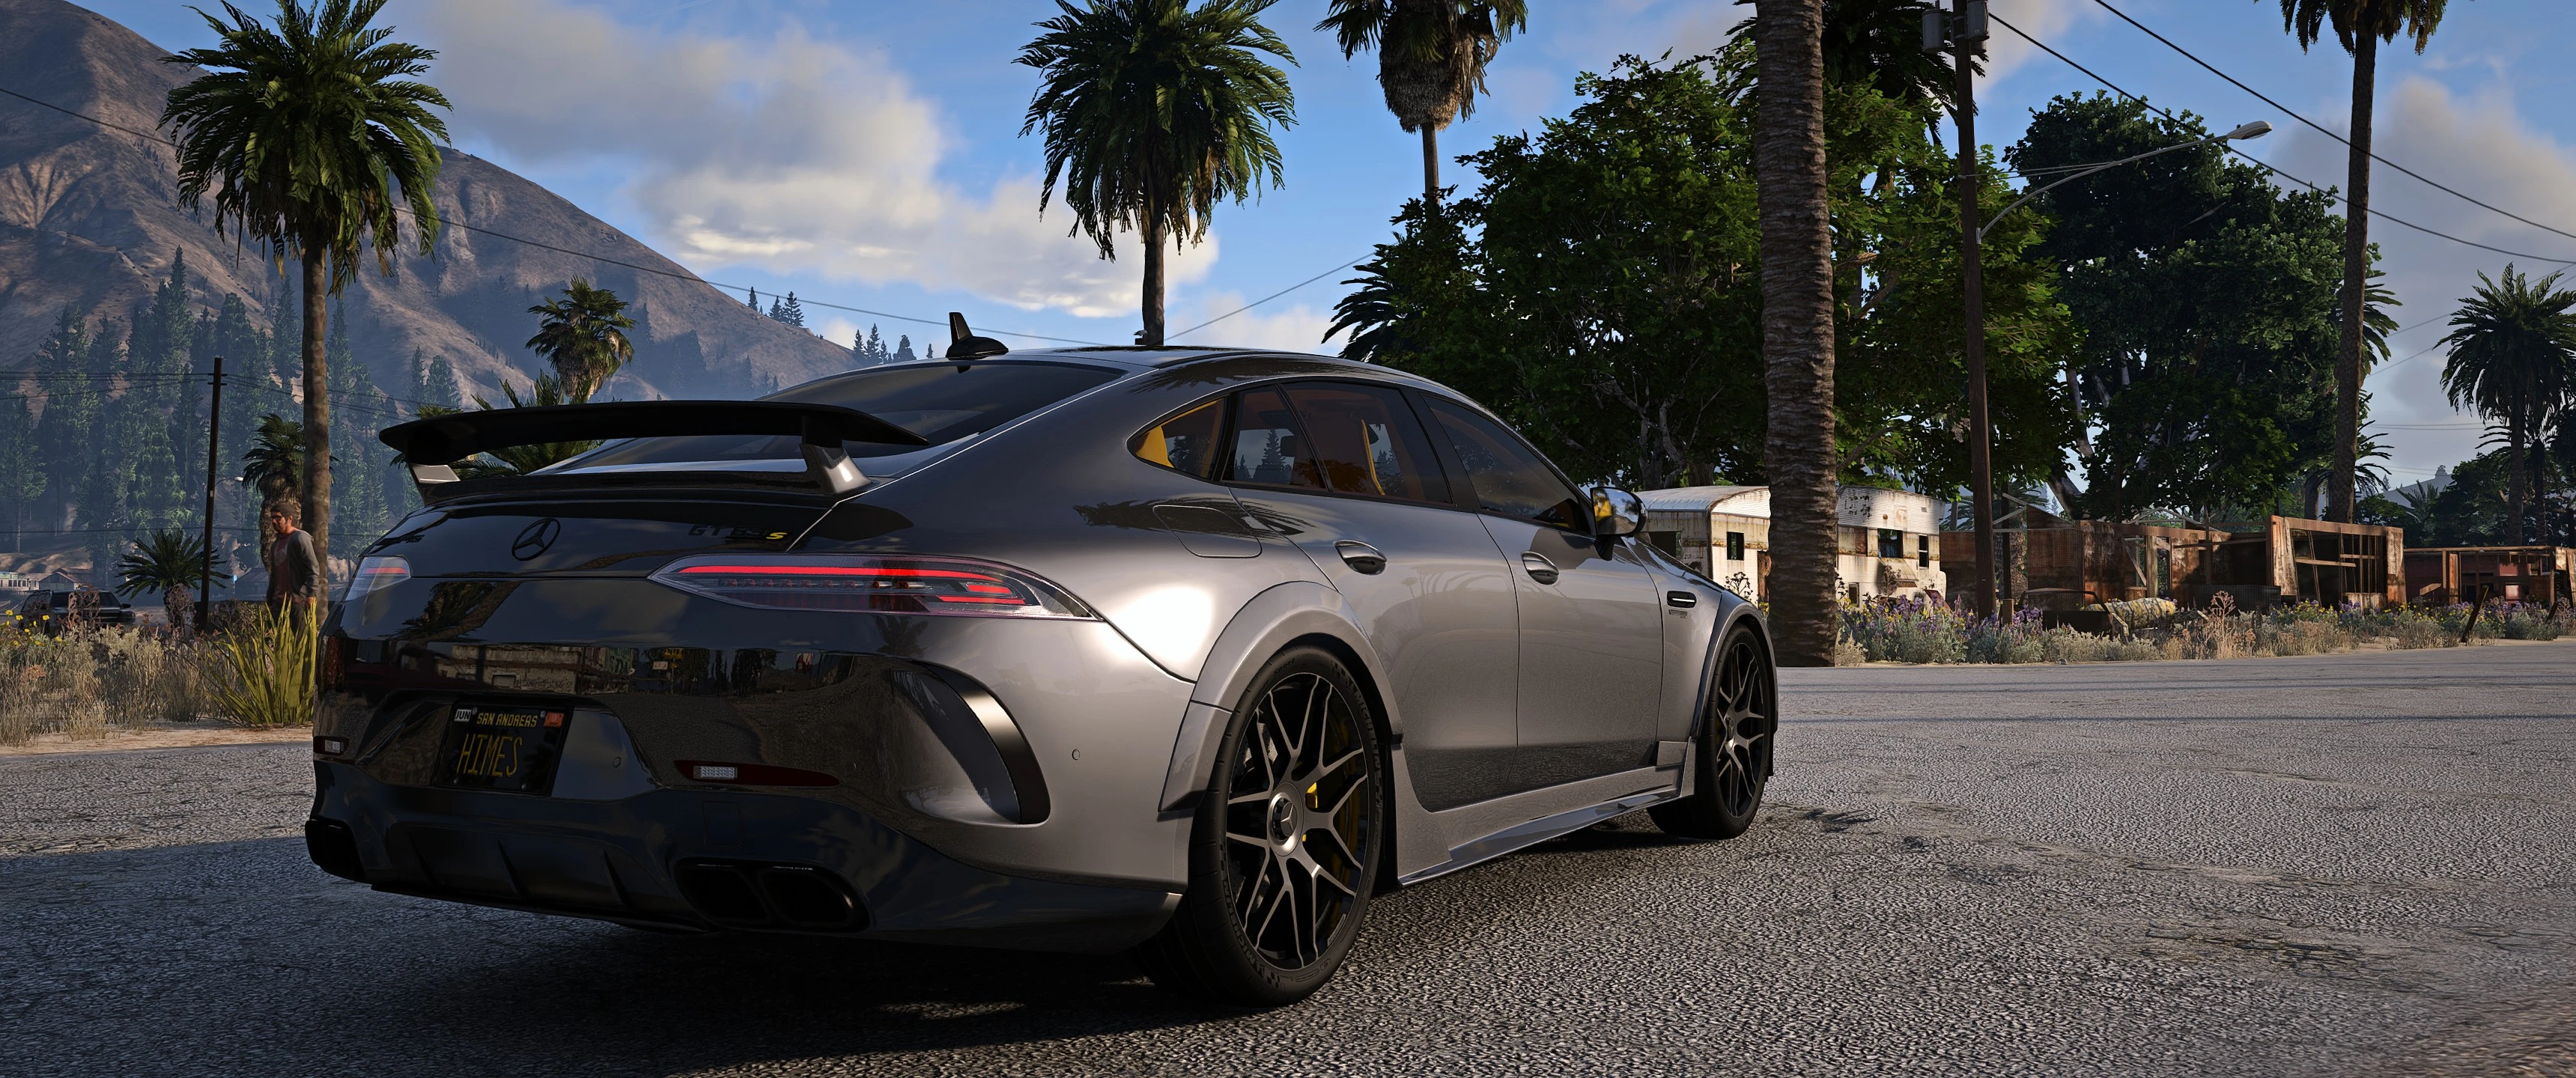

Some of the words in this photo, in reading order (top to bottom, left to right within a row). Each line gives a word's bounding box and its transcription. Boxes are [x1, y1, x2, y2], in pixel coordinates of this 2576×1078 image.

[455, 710, 471, 720] JUN
[476, 712, 495, 725] SAN
[495, 713, 538, 728] ANDREAS
[1353, 689, 1382, 773] MICHELIN
[456, 733, 523, 778] HIMES
